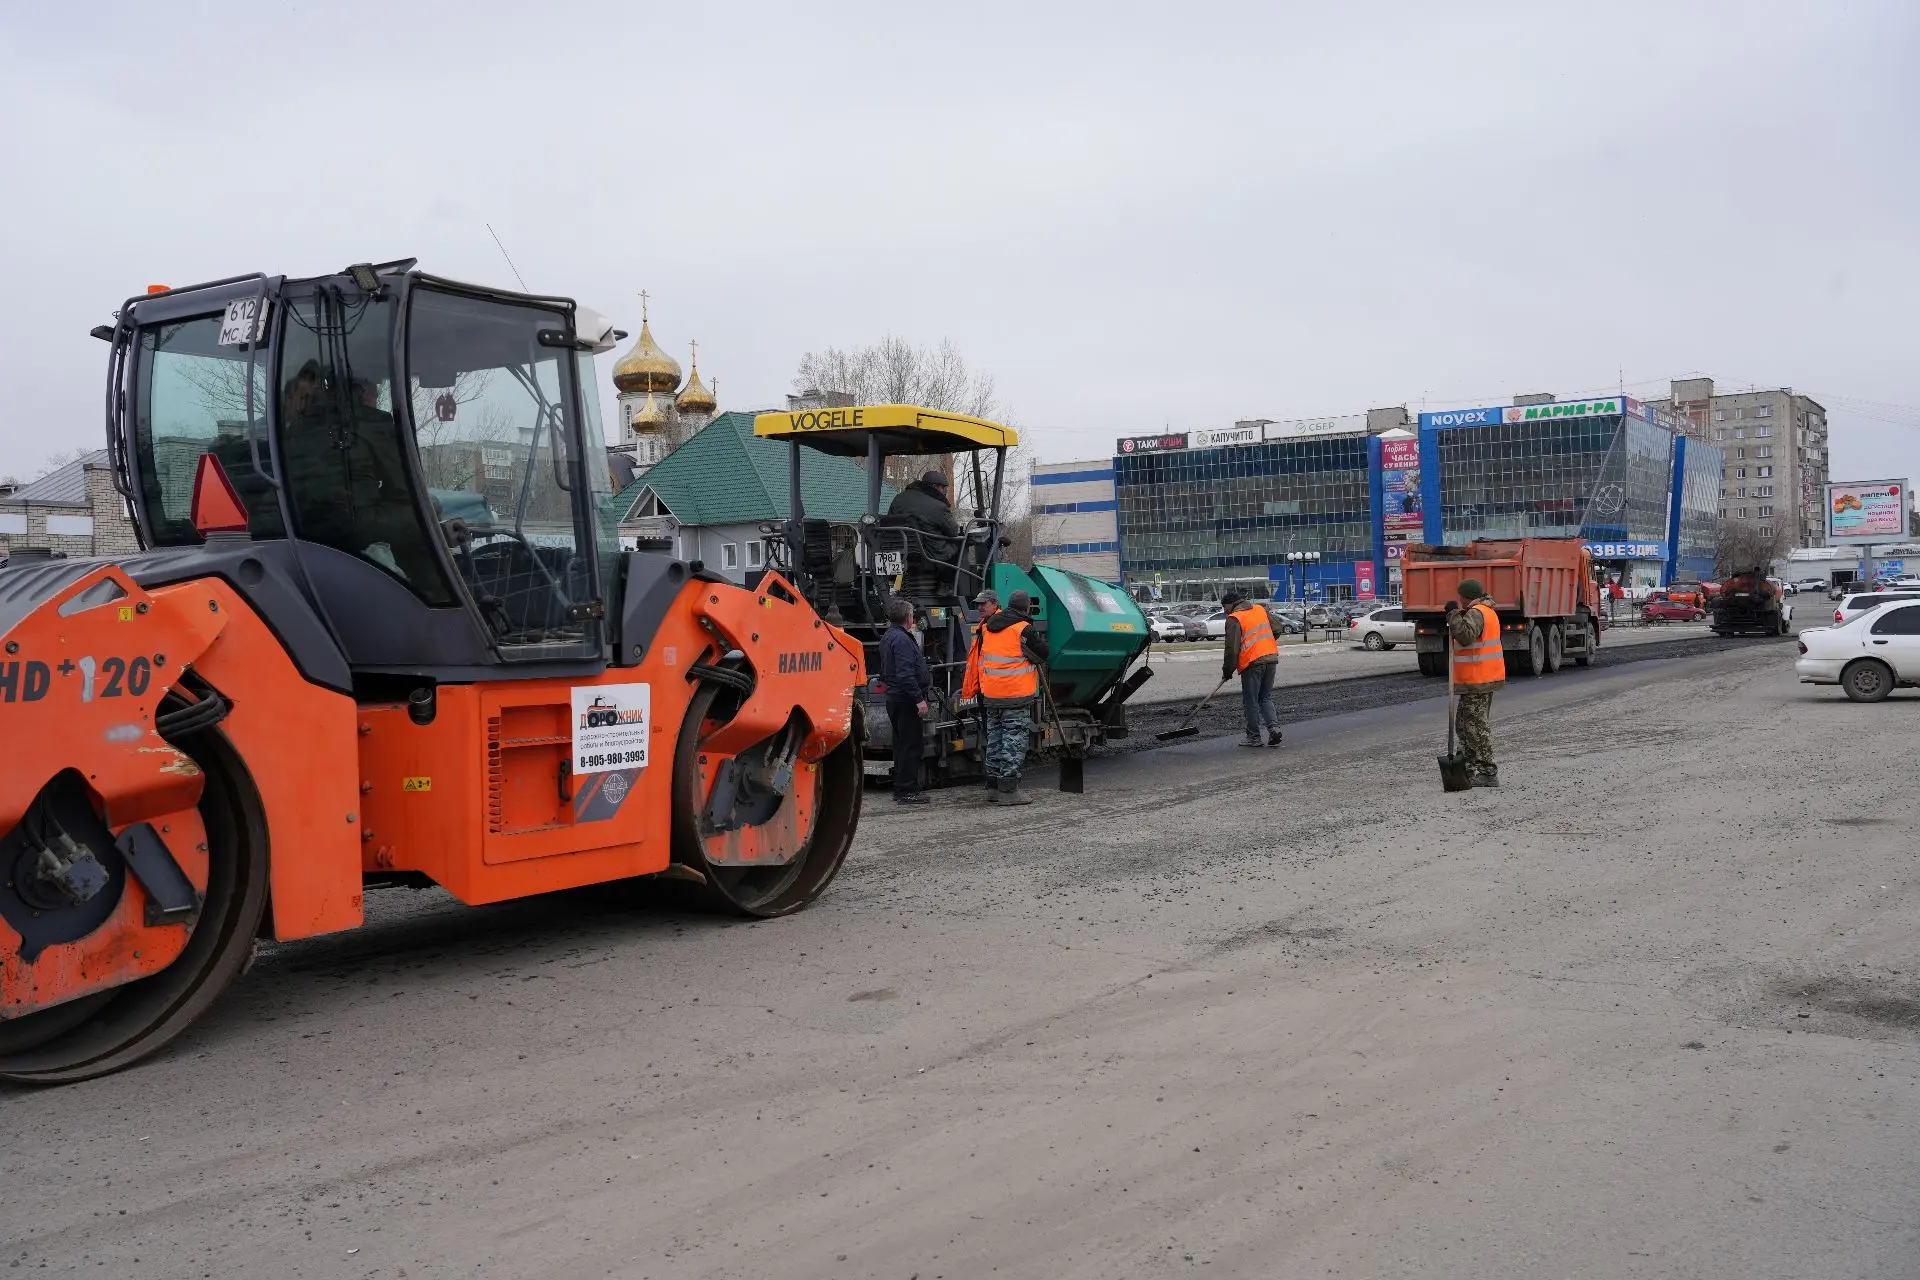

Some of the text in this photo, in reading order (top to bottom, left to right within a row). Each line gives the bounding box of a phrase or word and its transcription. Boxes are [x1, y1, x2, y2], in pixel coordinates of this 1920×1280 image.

[1525, 401, 1616, 419] МАРИЯ-РА
[1308, 422, 1335, 432] СБЕР
[1211, 430, 1253, 443] КАПУЧИТТО
[779, 652, 822, 673] HAMM
[580, 750, 645, 768] 8-905-980-3993
